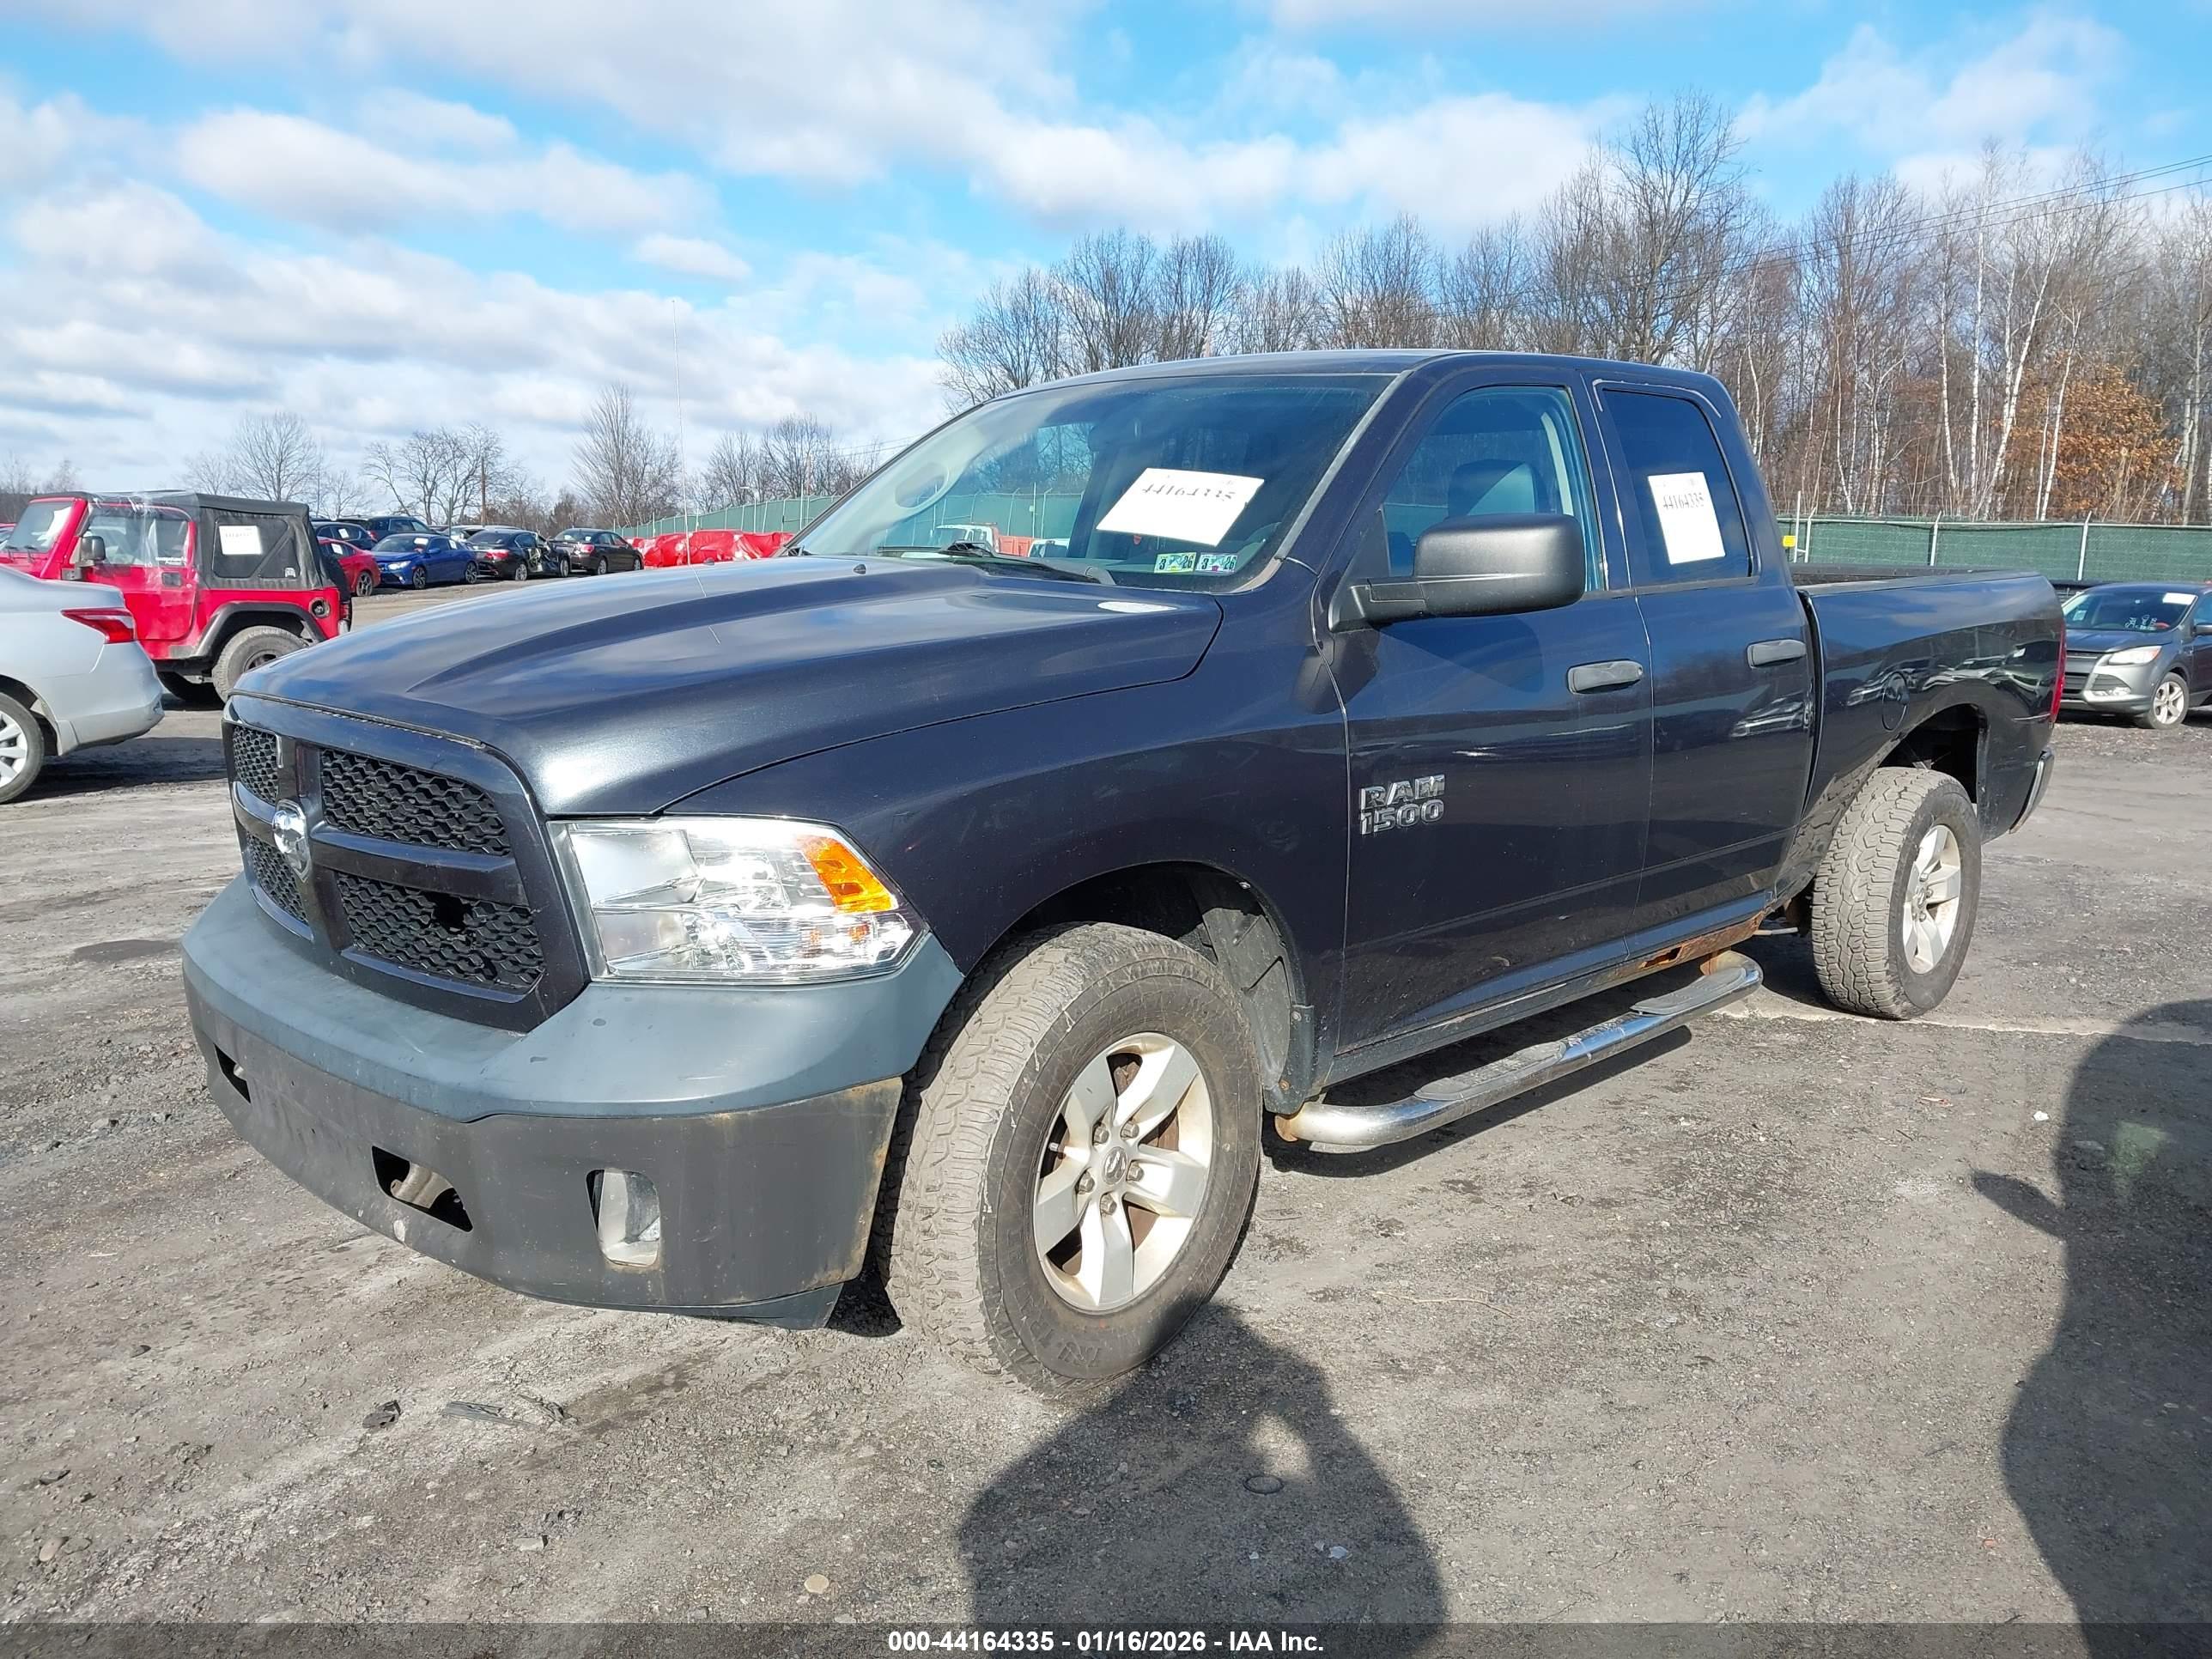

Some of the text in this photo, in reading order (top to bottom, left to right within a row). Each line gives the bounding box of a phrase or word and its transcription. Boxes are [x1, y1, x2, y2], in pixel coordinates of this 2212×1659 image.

[1158, 555, 1194, 570] 3 26
[1200, 556, 1237, 570] 3 26
[1359, 774, 1445, 810] RAM
[1359, 799, 1444, 836] 1500
